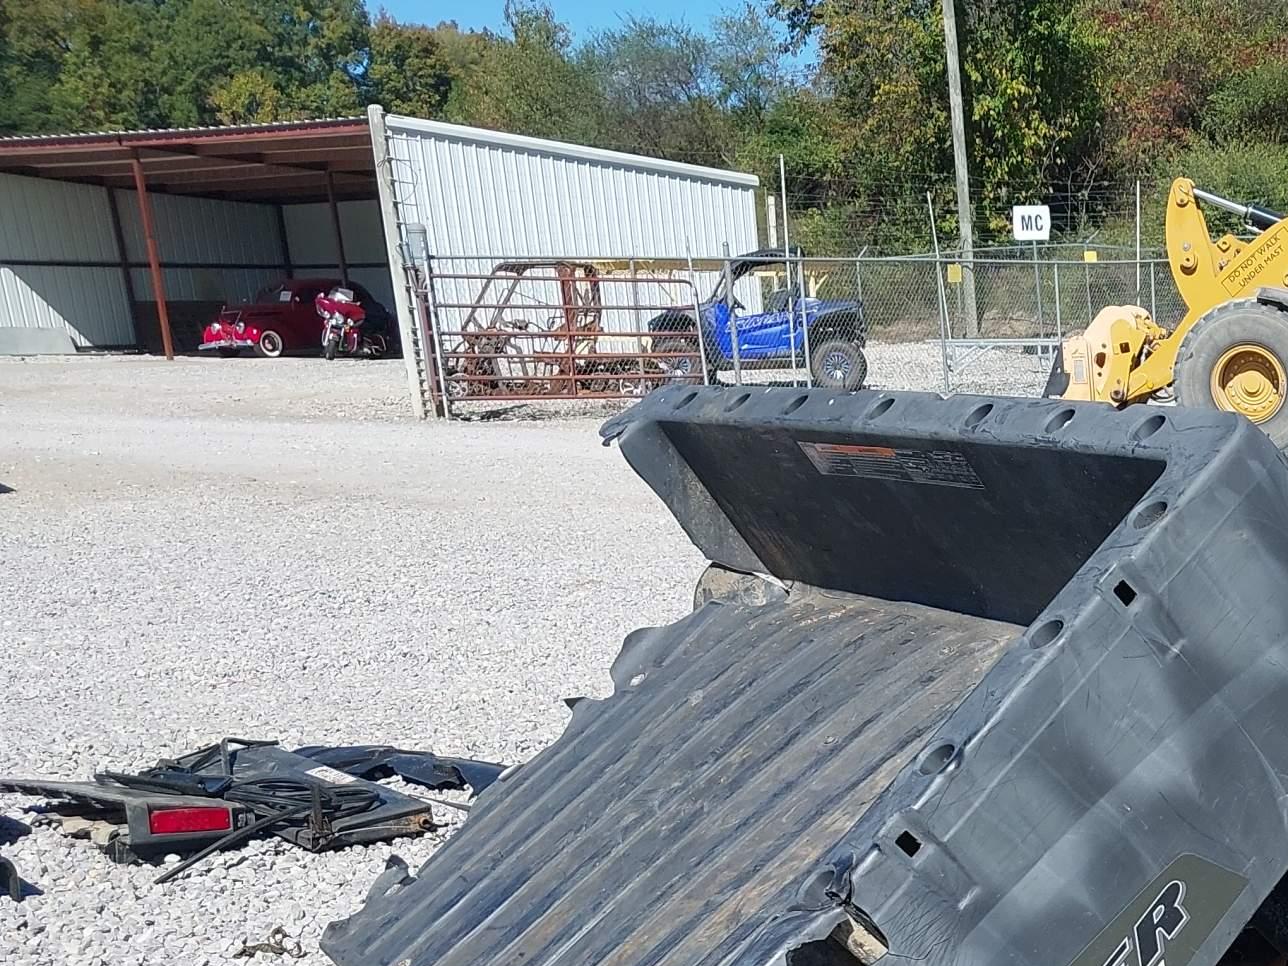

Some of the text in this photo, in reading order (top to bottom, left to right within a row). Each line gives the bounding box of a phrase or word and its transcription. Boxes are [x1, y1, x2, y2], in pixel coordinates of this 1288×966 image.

[1021, 214, 1044, 231] MC
[1228, 233, 1281, 283] DO NOT WALK
[1238, 244, 1285, 288] UNDER MAST
